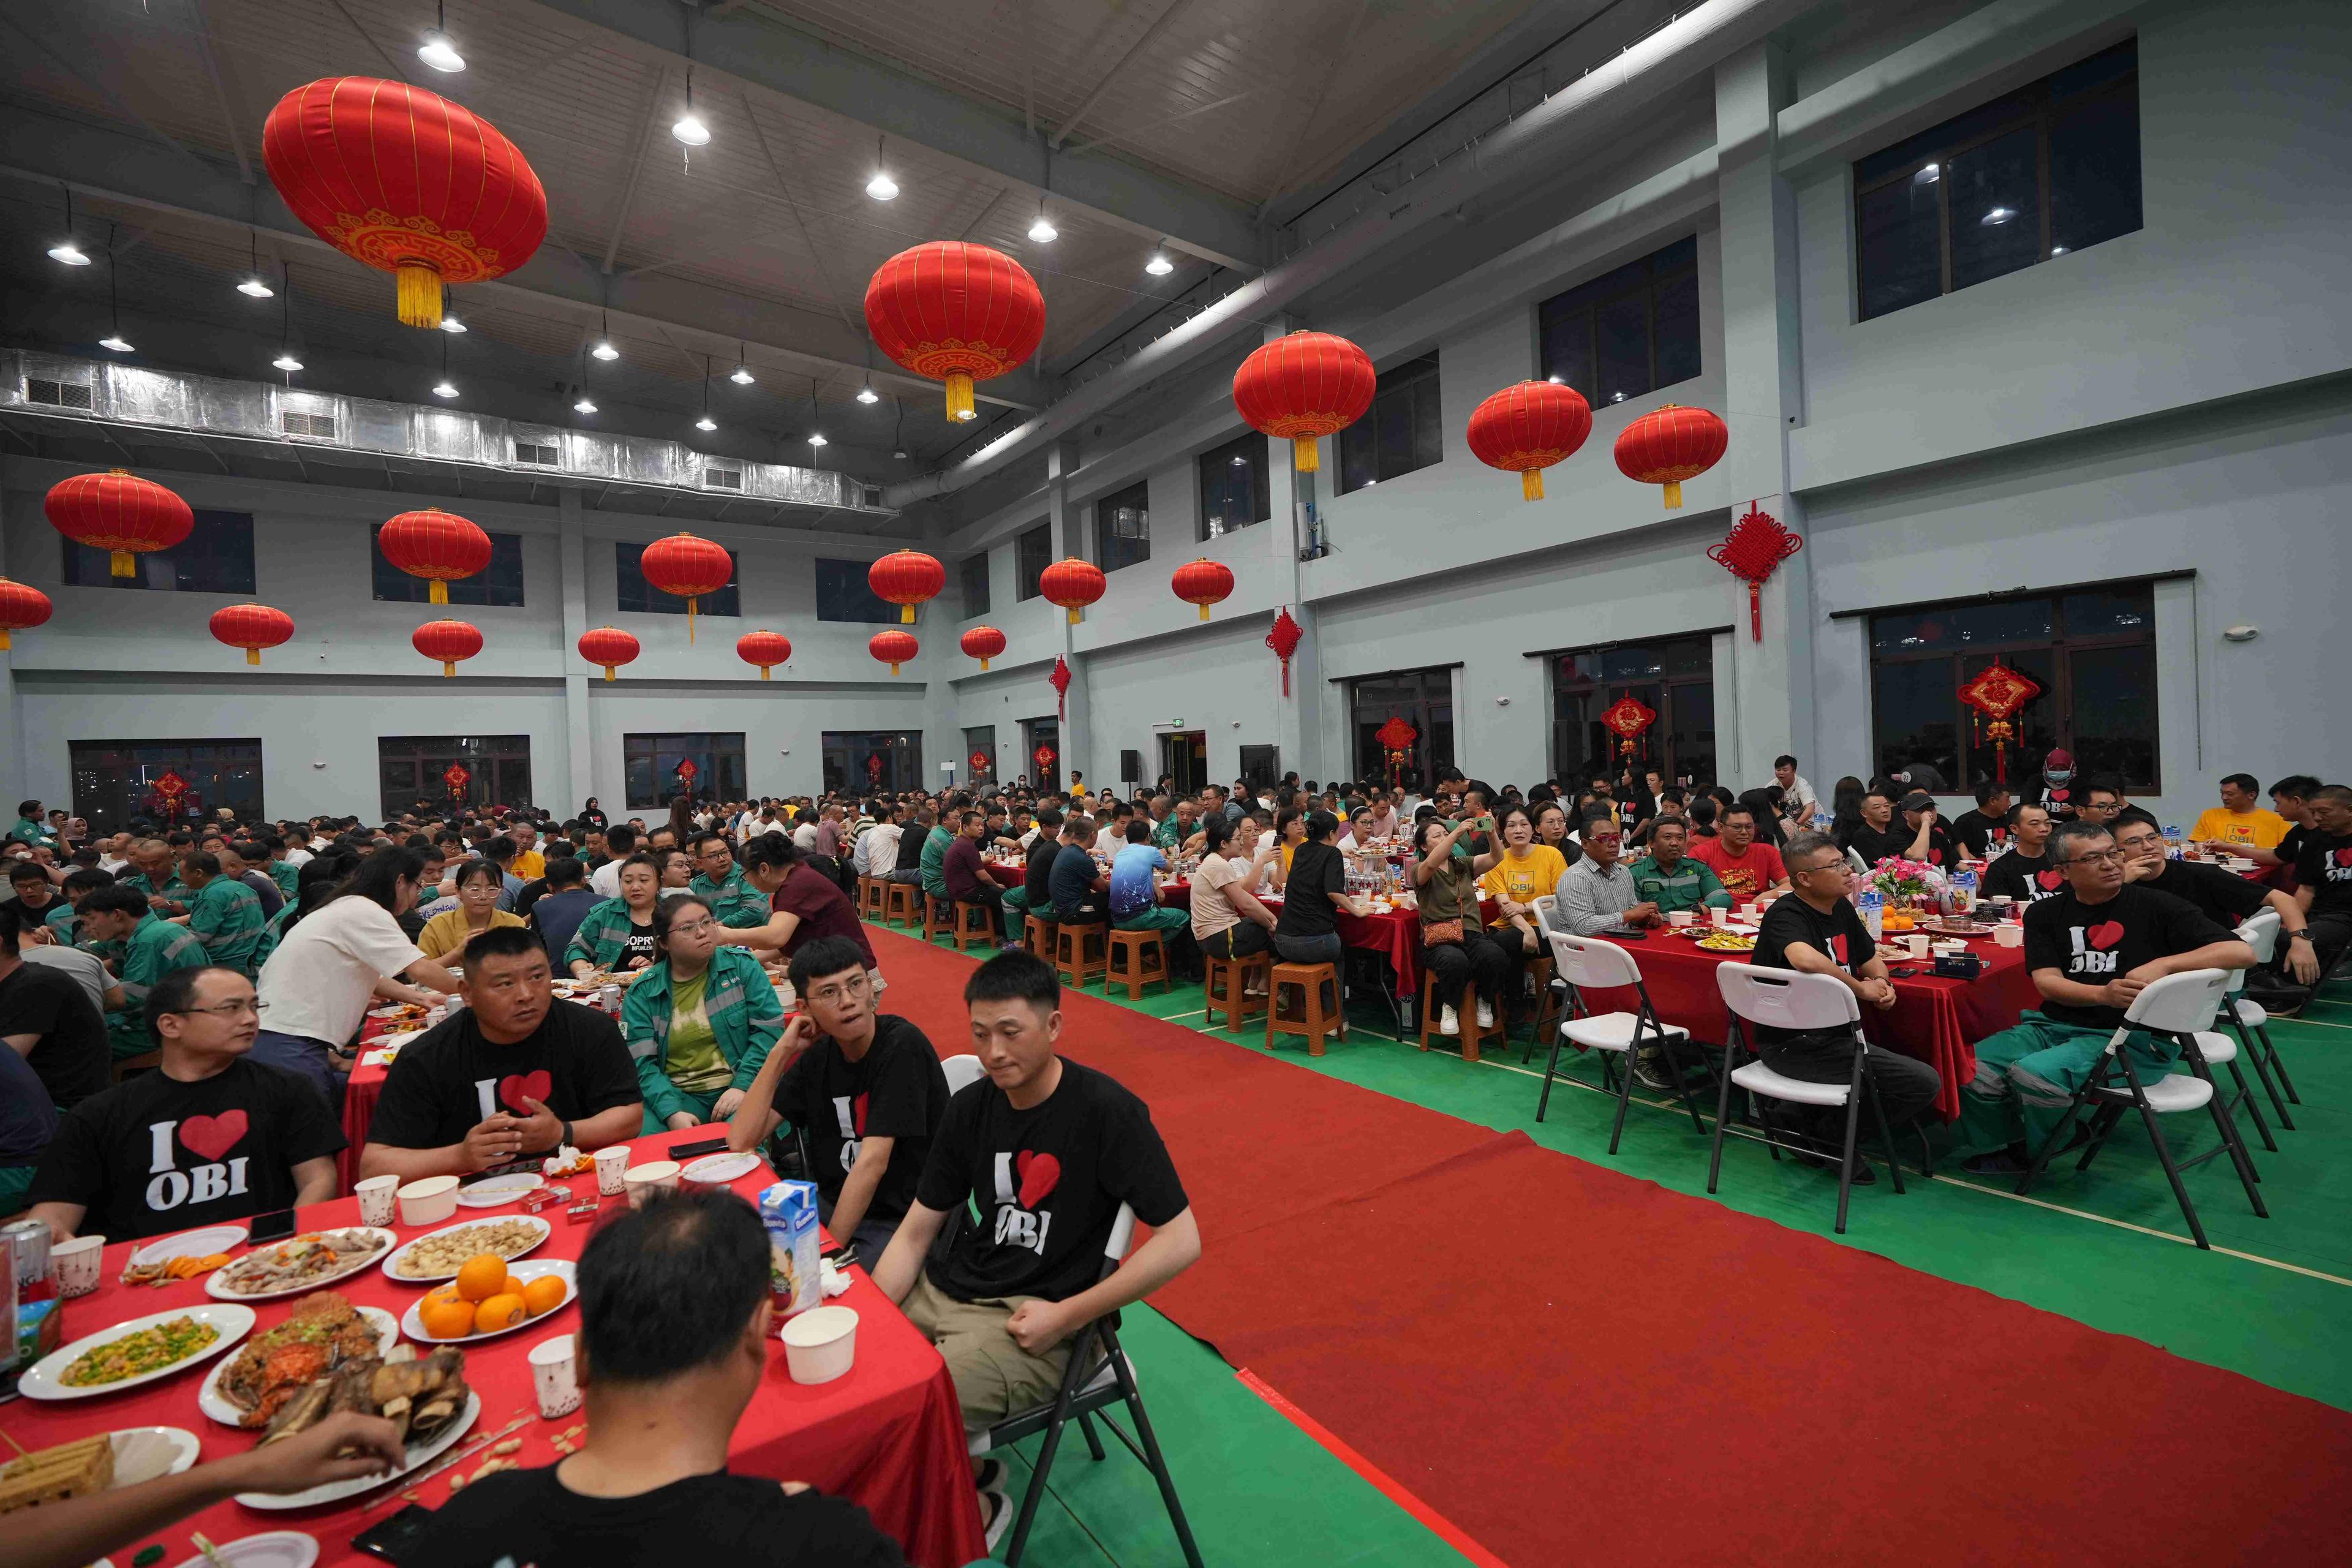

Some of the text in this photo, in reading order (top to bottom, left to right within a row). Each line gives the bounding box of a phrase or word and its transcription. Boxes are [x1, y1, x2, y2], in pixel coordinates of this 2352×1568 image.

[2040, 788, 2051, 802] I
[1620, 813, 1635, 823] OBI
[1621, 802, 1627, 813] I
[2039, 801, 2068, 813] OB
[1985, 829, 1993, 843] I
[2230, 835, 2249, 843] OBI
[2324, 850, 2337, 870] I
[2022, 873, 2037, 895] I
[2069, 926, 2085, 956] I
[2068, 950, 2119, 973] OBI
[474, 1078, 497, 1122] I
[832, 1096, 856, 1139] I
[149, 1120, 178, 1174] I
[146, 1156, 249, 1211] OBI
[995, 1152, 1017, 1205] I
[995, 1204, 1052, 1256] OBI
